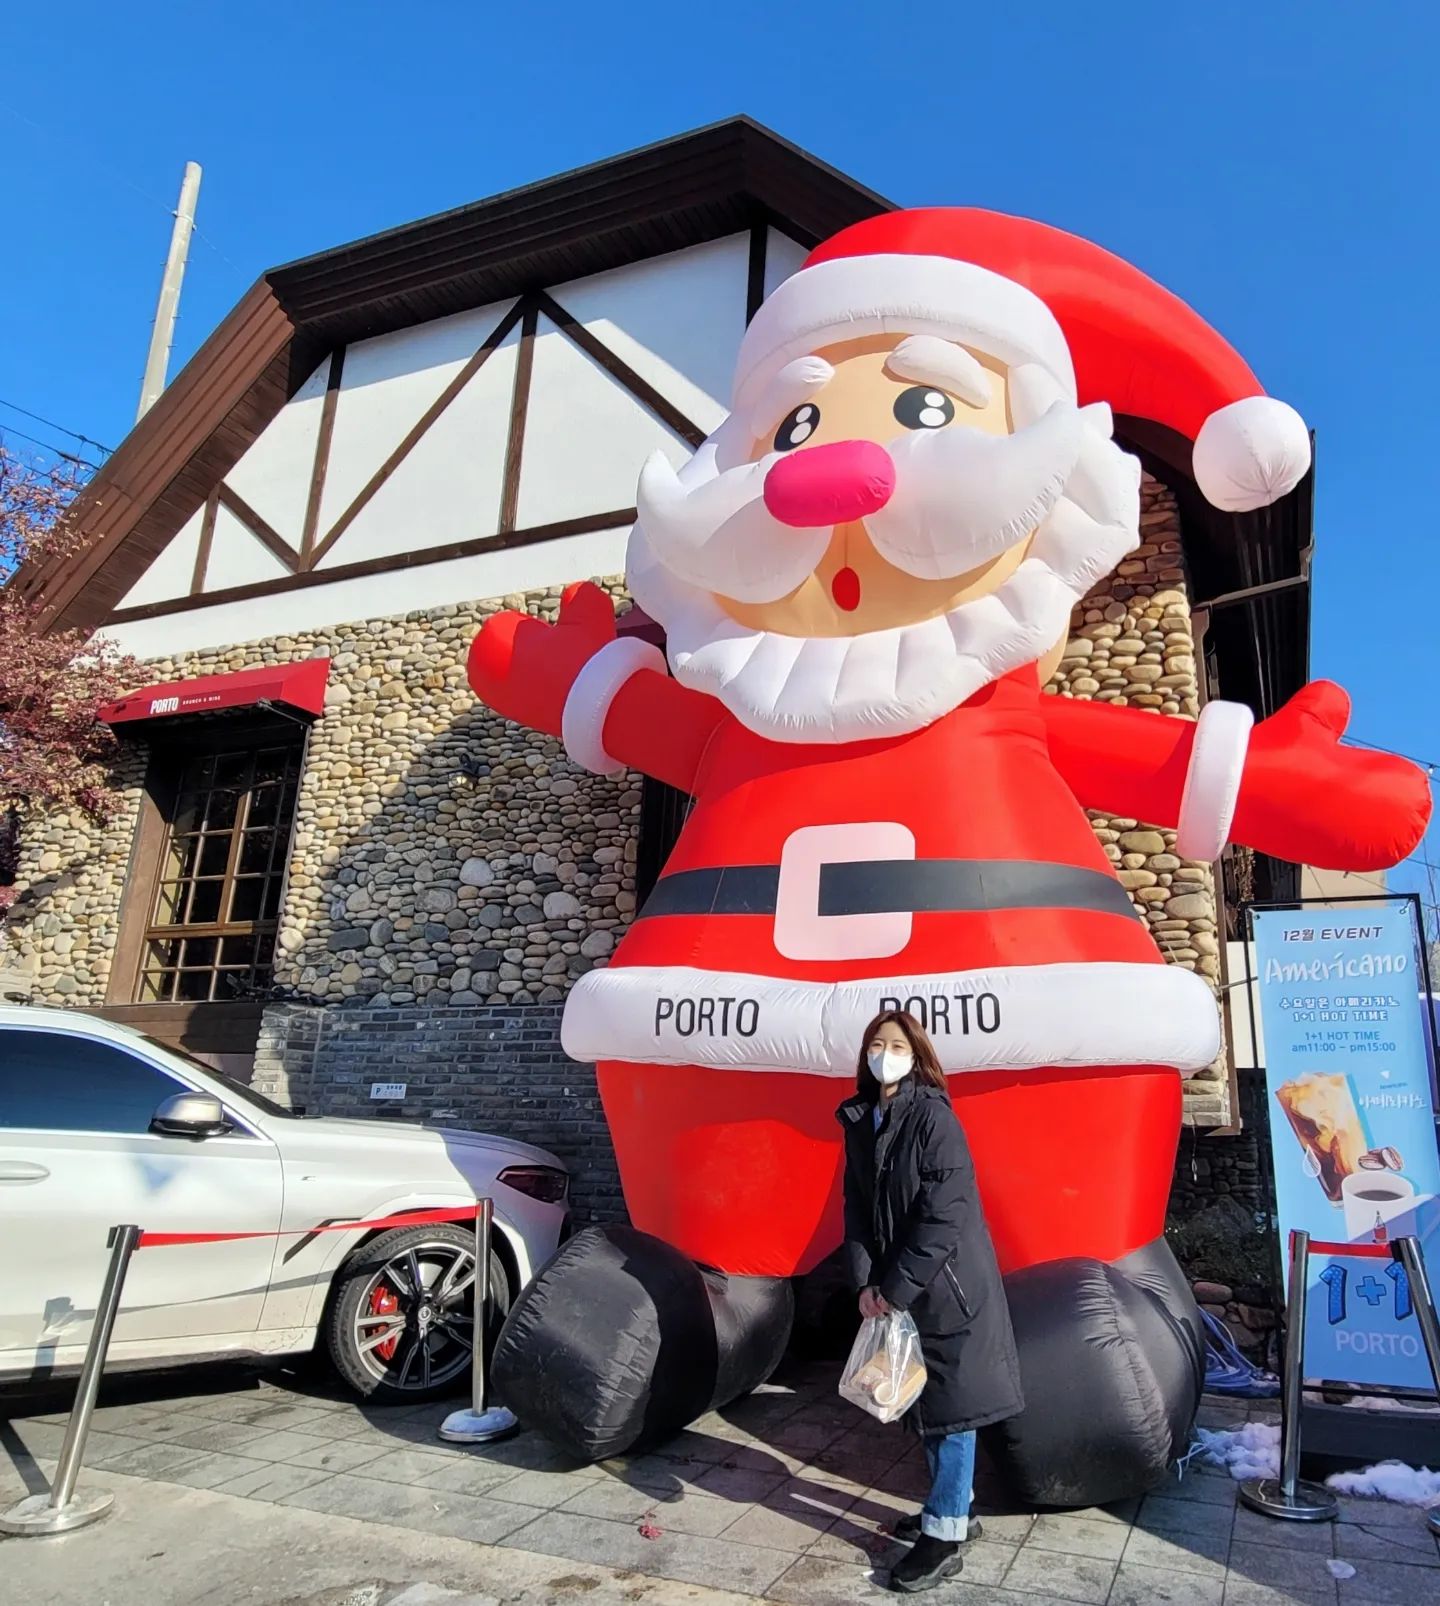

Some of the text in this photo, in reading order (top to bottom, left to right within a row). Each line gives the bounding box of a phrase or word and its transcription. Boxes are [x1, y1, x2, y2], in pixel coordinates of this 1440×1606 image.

[150, 696, 179, 715] PORTO
[1283, 926, 1383, 942] 12월 EVENT
[1264, 951, 1408, 985] Americano
[1278, 995, 1401, 1009] 수요일은 아메리카노
[655, 997, 760, 1037] PORTO
[1292, 1009, 1388, 1022] 1+1 HOT TIME
[1304, 1031, 1381, 1041] 1+1 HOT TIME
[1291, 1042, 1336, 1052] am11:00
[1350, 1042, 1397, 1053] pm15:00
[1319, 1261, 1412, 1325] 1+1
[1335, 1330, 1419, 1357] PORTO
